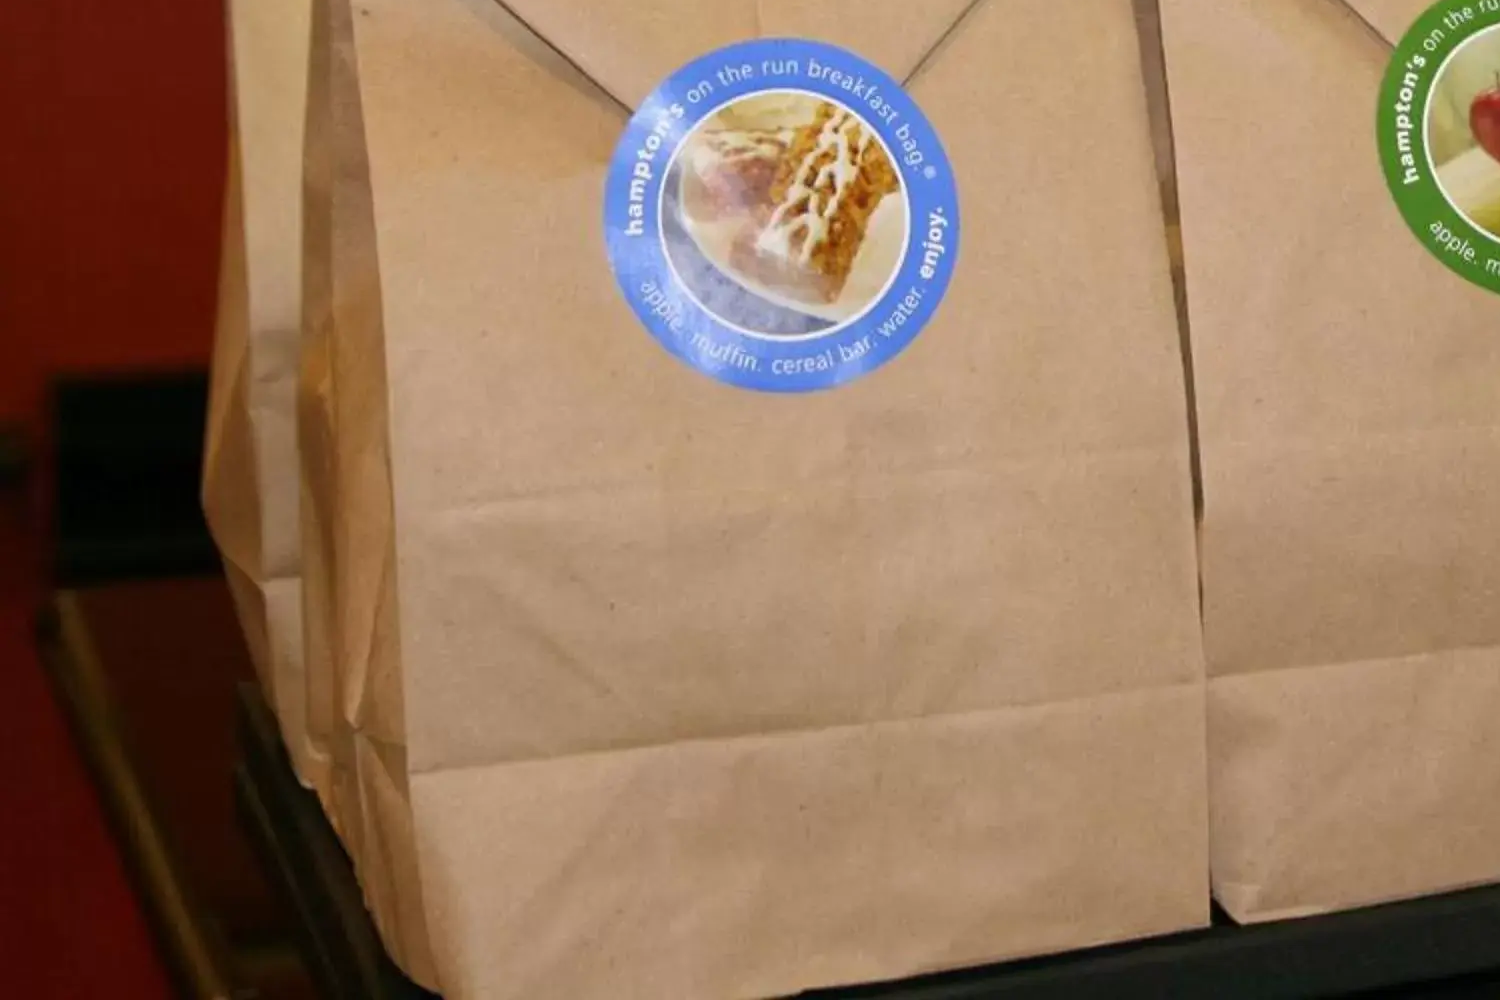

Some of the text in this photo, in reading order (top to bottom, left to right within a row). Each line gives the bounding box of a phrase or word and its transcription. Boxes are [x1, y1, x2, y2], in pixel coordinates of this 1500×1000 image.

[687, 78, 714, 103] on
[717, 60, 752, 86] the
[762, 59, 799, 77] run
[808, 60, 898, 126] breakfast
[1395, 54, 1427, 185] hampton's
[1423, 28, 1445, 52] on
[1444, 5, 1474, 32] the
[771, 352, 835, 375] cereal
[919, 206, 949, 280] enjoy.
[1429, 220, 1477, 265] apple.
